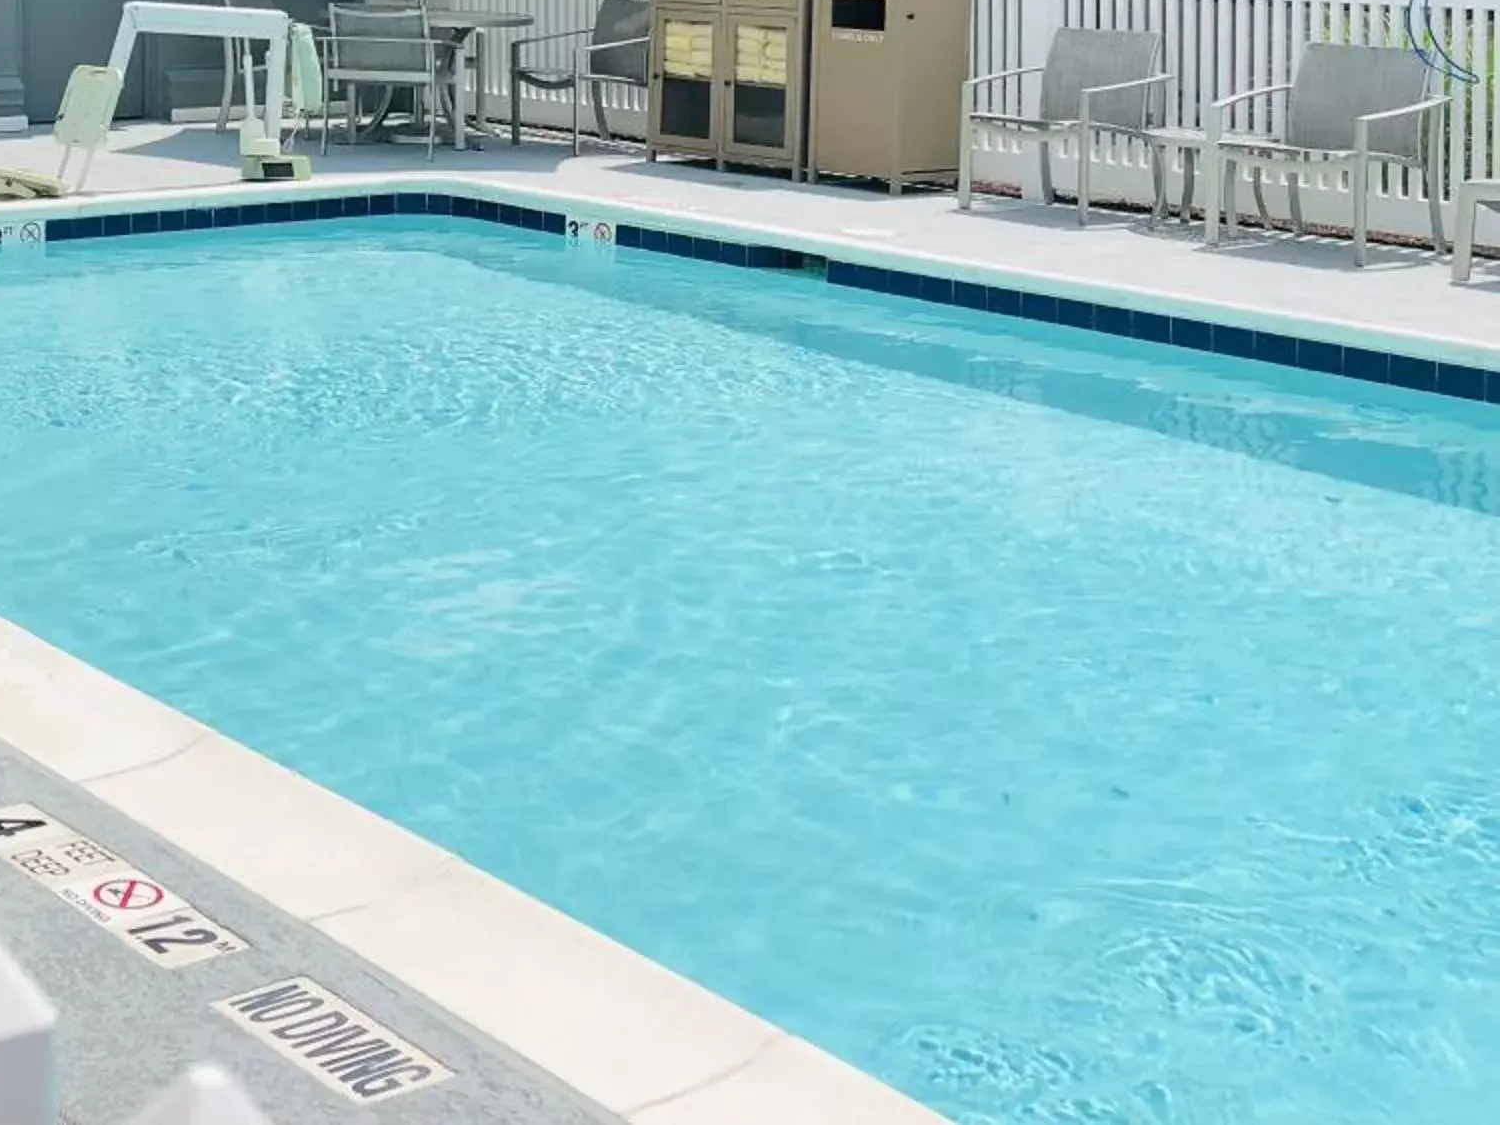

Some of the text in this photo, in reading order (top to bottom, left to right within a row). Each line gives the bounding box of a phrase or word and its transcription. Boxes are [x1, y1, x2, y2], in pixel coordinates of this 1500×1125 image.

[11, 849, 70, 875] DEEP
[55, 840, 116, 865] FEET
[227, 984, 432, 1098] NO DIVING
